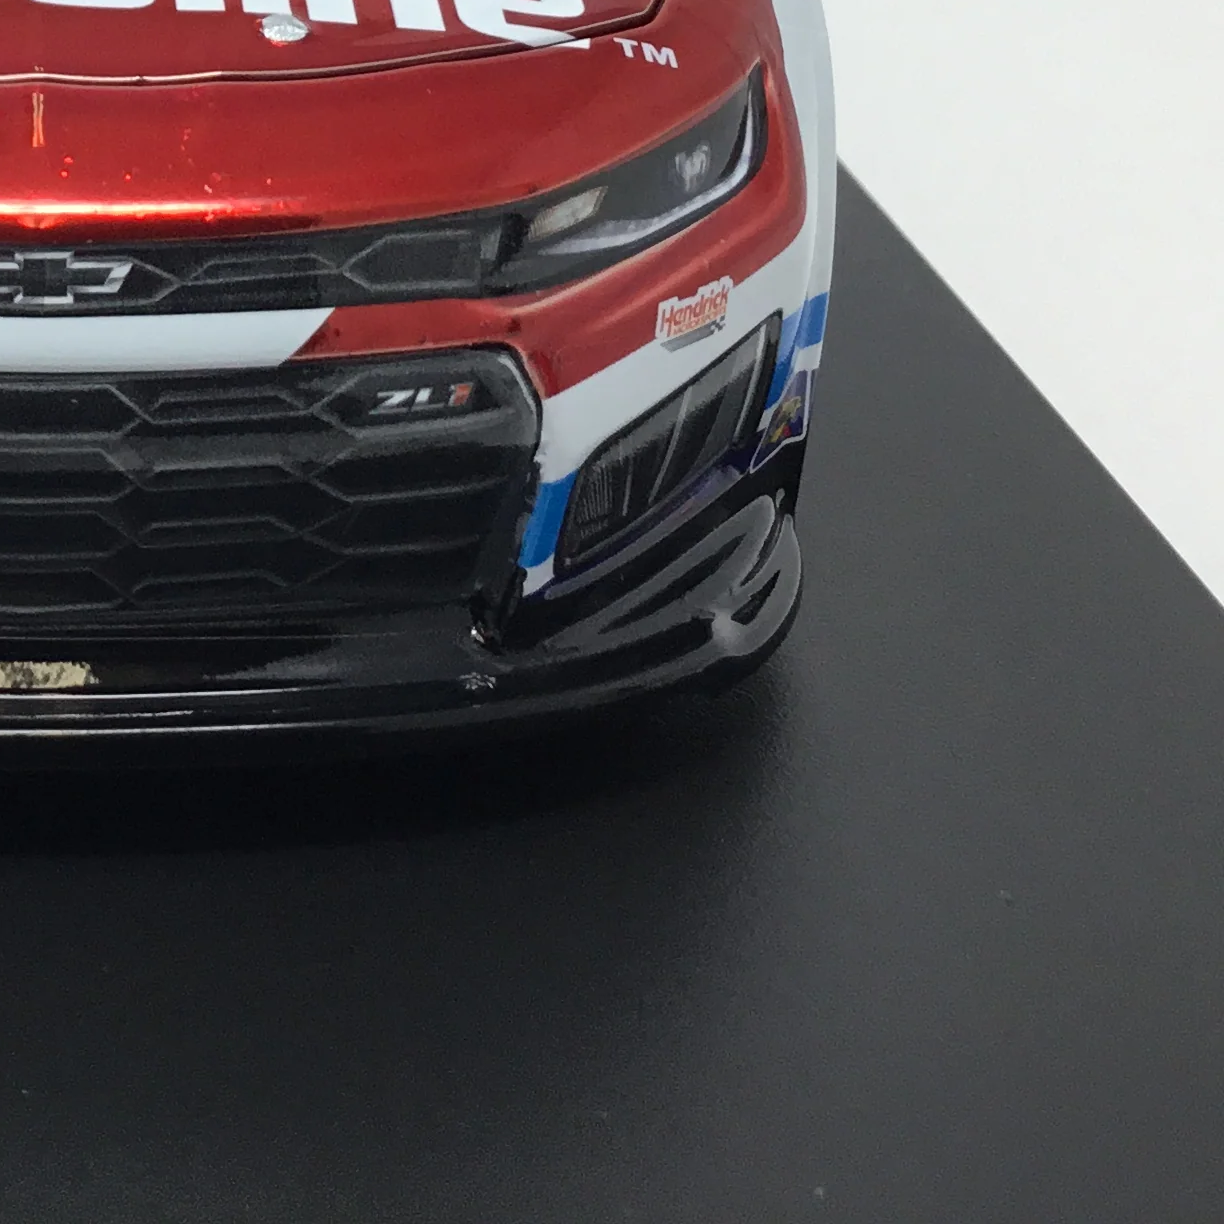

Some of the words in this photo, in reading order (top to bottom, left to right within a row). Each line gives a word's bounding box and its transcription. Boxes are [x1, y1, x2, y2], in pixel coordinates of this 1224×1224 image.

[613, 36, 679, 69] TM
[660, 283, 730, 338] Hendrick
[368, 382, 474, 415] ZL1
